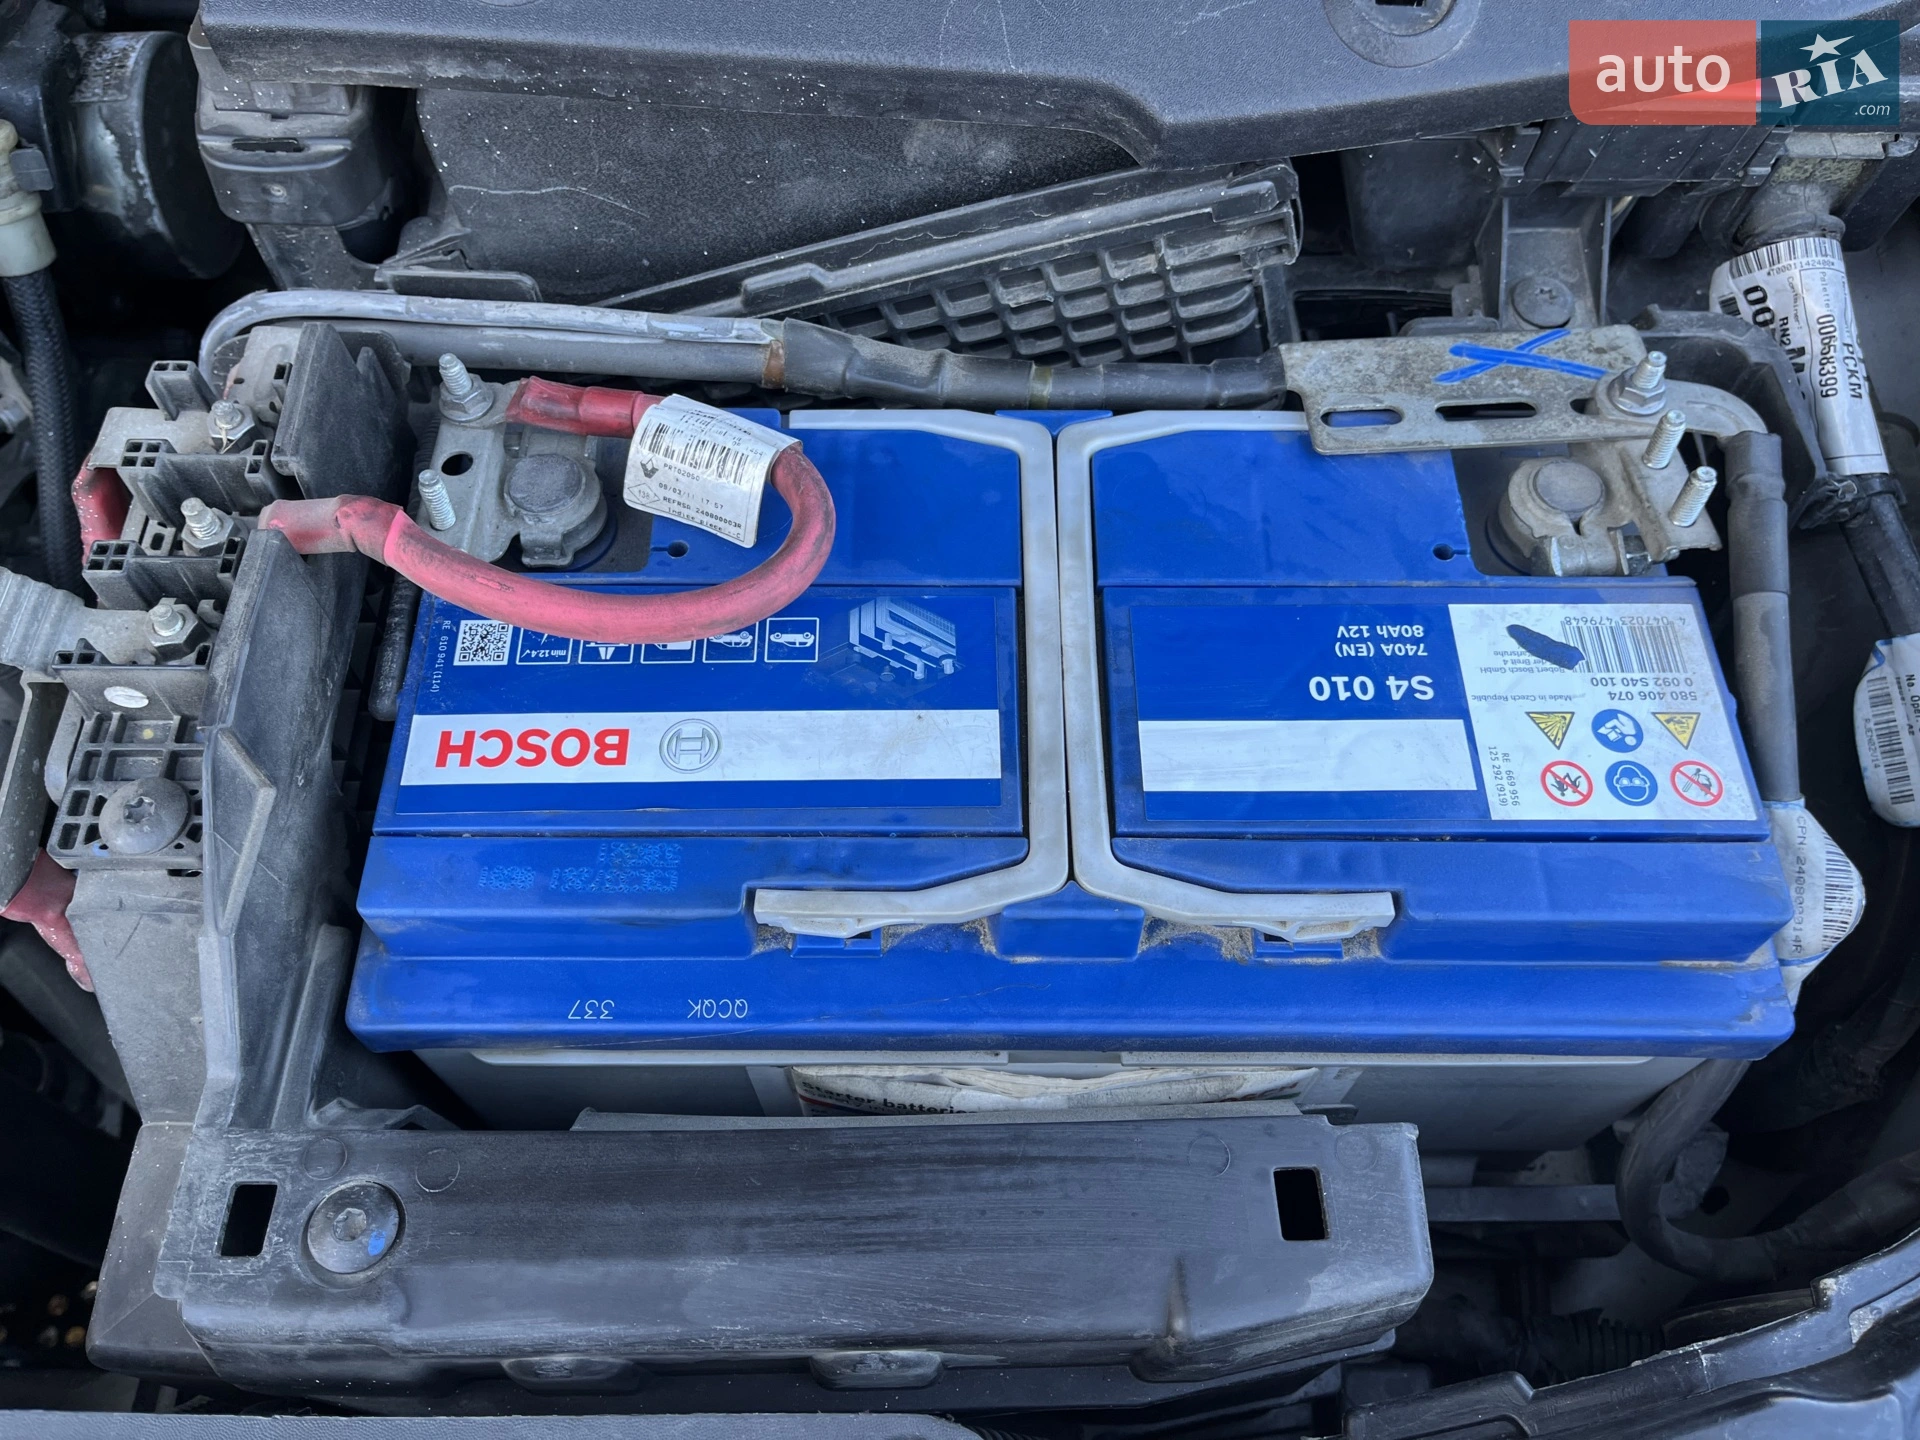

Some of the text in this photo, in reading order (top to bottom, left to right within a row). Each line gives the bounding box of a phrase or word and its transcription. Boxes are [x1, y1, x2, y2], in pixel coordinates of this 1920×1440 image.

[1816, 314, 1839, 398] 00658399
[1563, 615, 1613, 626] 479648
[1620, 615, 1670, 626] 047023
[1336, 625, 1425, 638] 80Ah 12V
[430, 620, 452, 693] RE 610 941 (114)
[531, 649, 567, 658] min 12.4
[1334, 641, 1429, 657] 740A (EN)
[1480, 666, 1506, 674] GmbH
[1508, 666, 1534, 674] Bosch
[1308, 675, 1435, 701] S4 010
[1590, 677, 1694, 687] 0 092 S40 100
[1471, 694, 1572, 703] Made in Czech Republic
[1607, 690, 1698, 701] 580 406 074
[435, 728, 630, 768] BOSCH
[1488, 746, 1508, 807] 125 292 (919)
[1501, 752, 1521, 806] RE 669 956
[1796, 816, 1807, 850] CPN:
[567, 998, 749, 1019] QCQK 337
[801, 1081, 877, 1104] Starter
[883, 1097, 979, 1114] batteri
